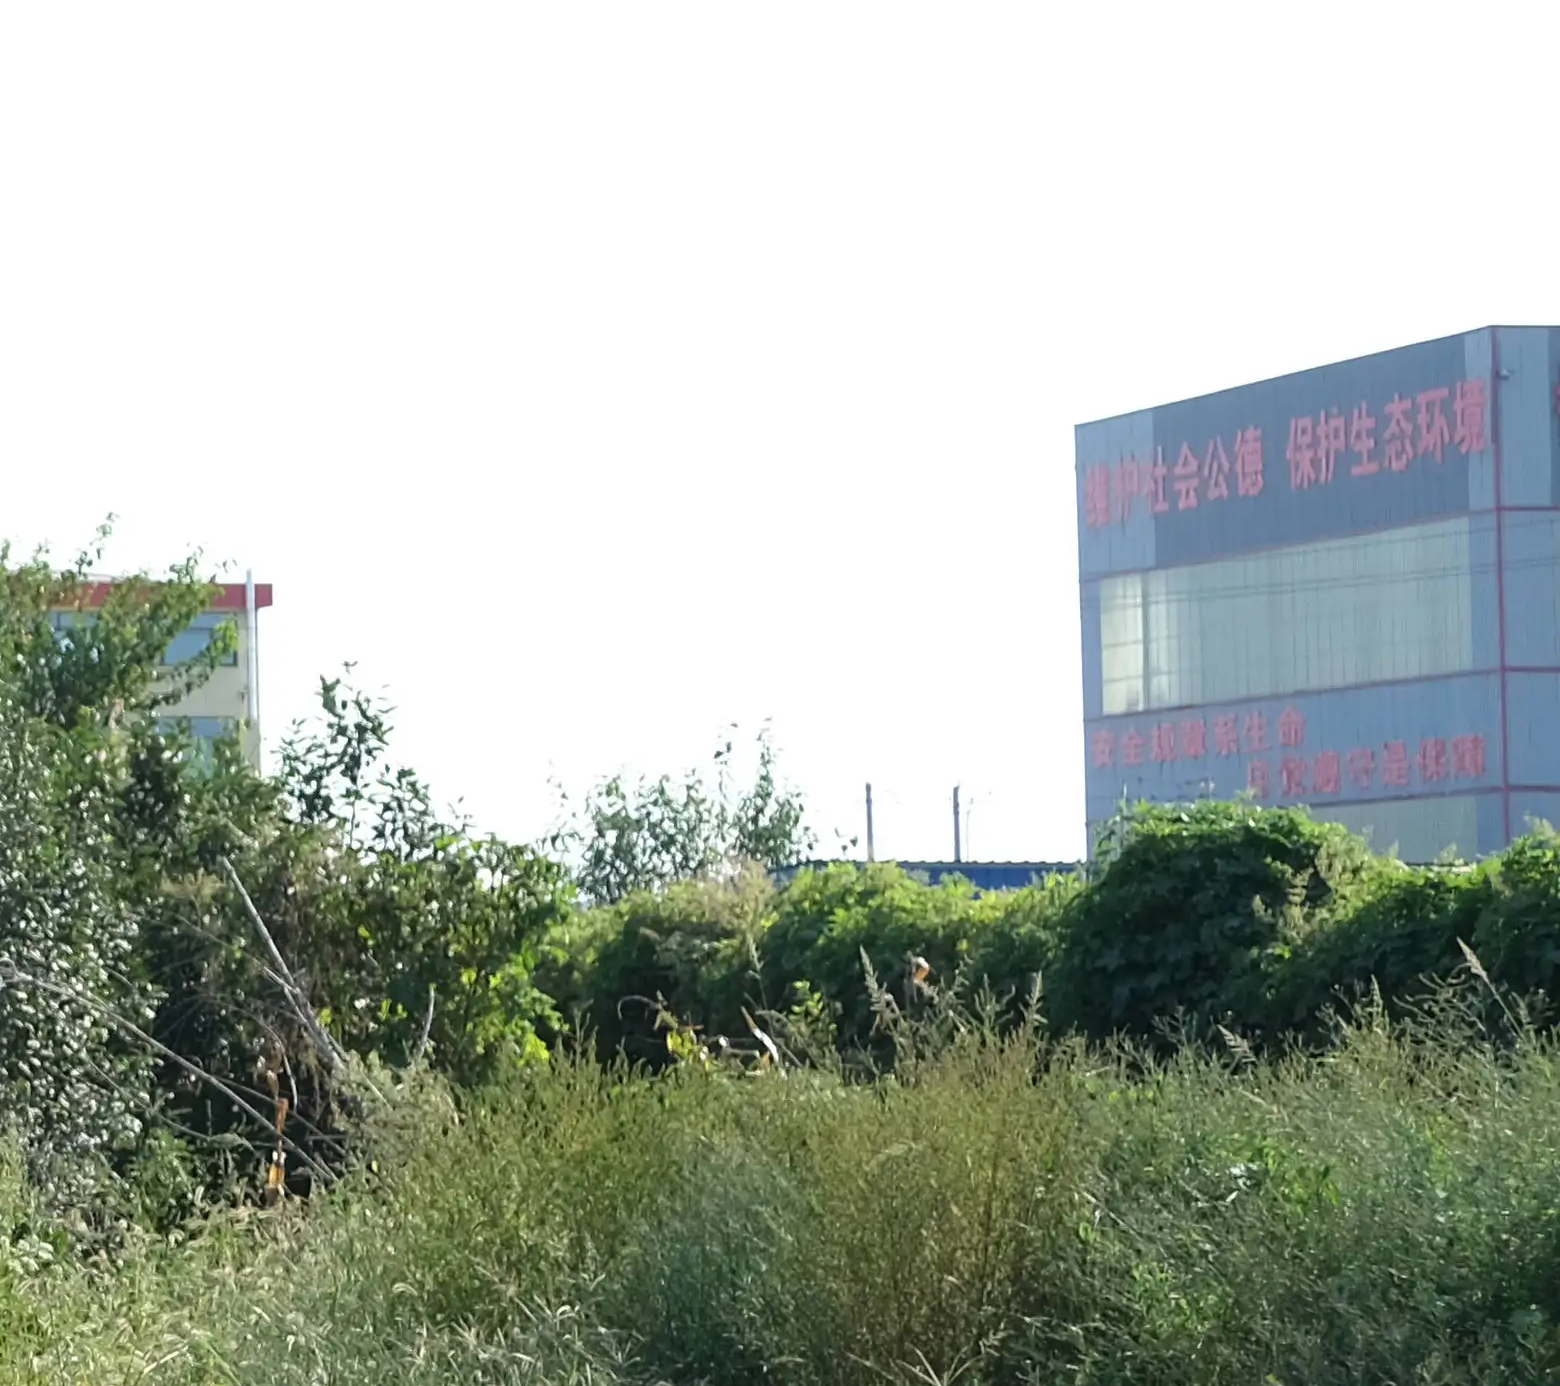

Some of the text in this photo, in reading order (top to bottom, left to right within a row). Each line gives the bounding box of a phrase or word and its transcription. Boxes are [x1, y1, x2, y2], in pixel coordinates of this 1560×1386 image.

[1286, 378, 1488, 490] 保护生态环境
